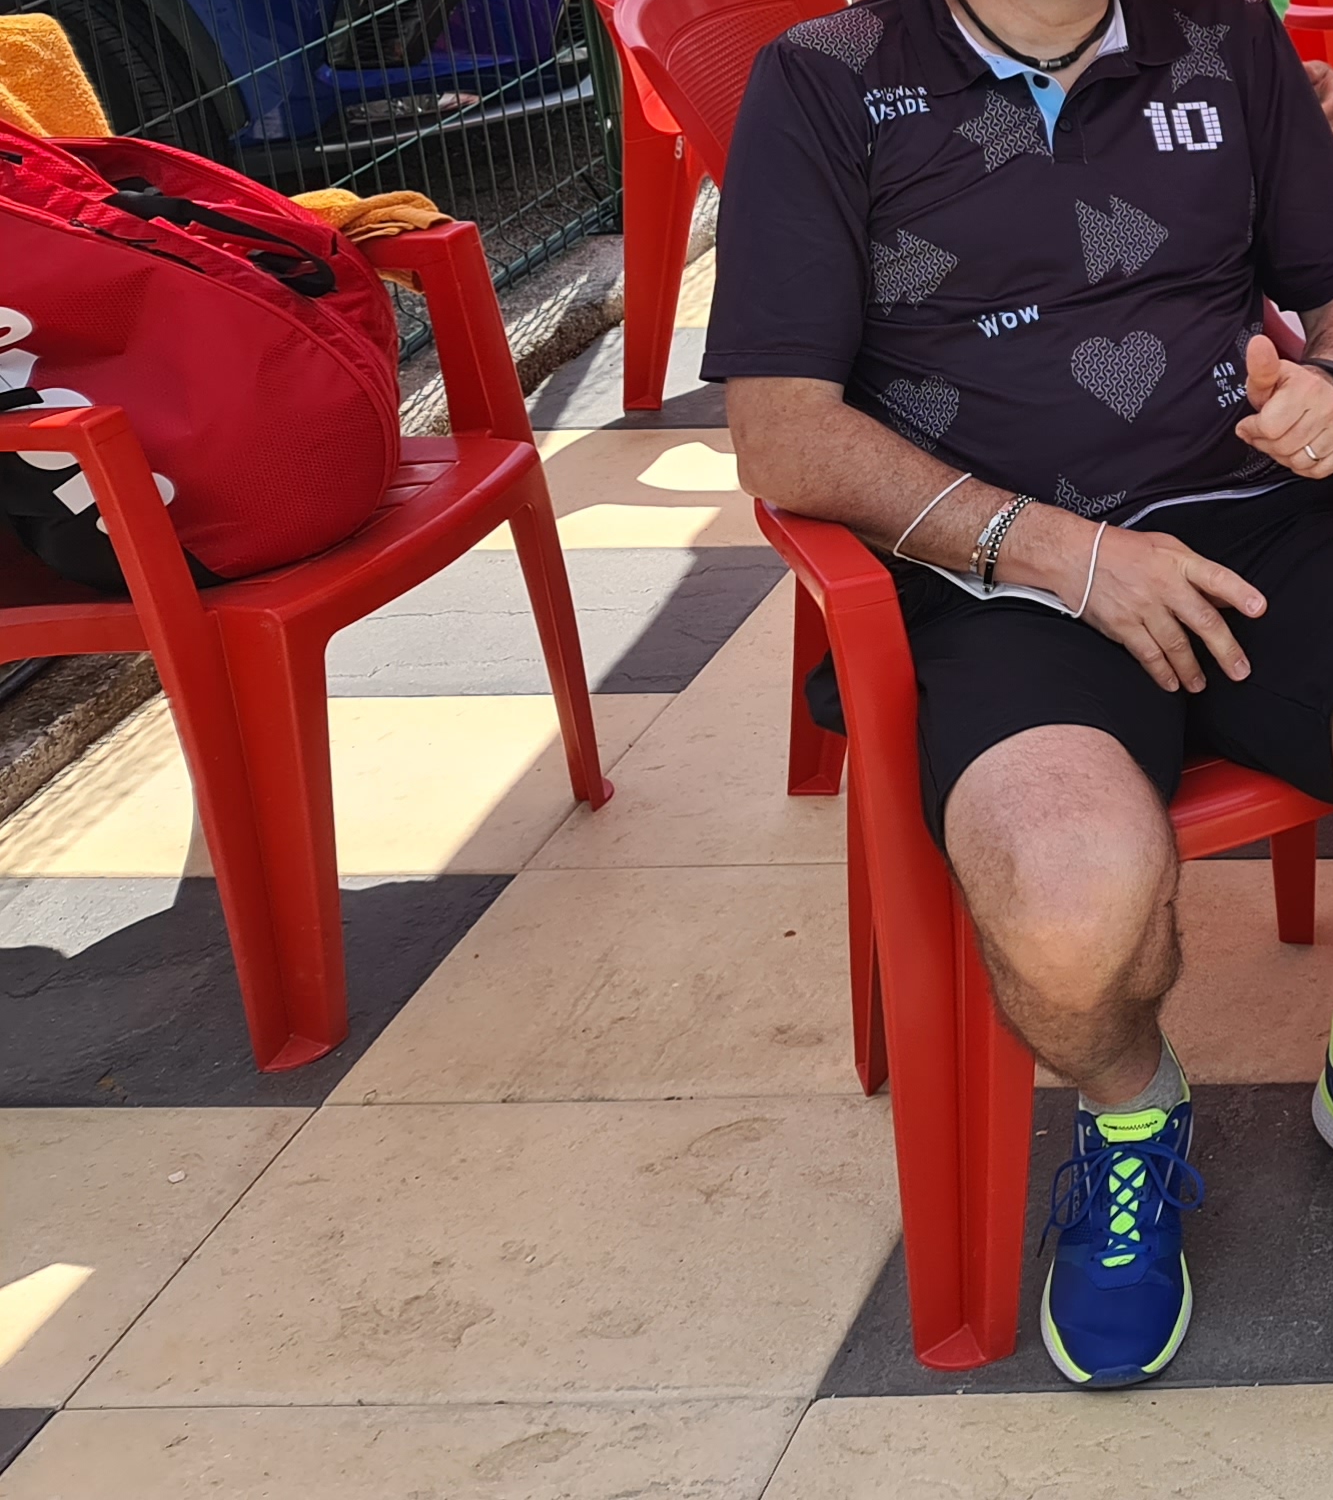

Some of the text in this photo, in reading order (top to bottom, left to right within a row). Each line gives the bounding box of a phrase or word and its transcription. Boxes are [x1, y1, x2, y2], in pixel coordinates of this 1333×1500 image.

[1143, 101, 1223, 152] 10
[977, 304, 1040, 338] WOW
[1213, 361, 1236, 379] AIR
